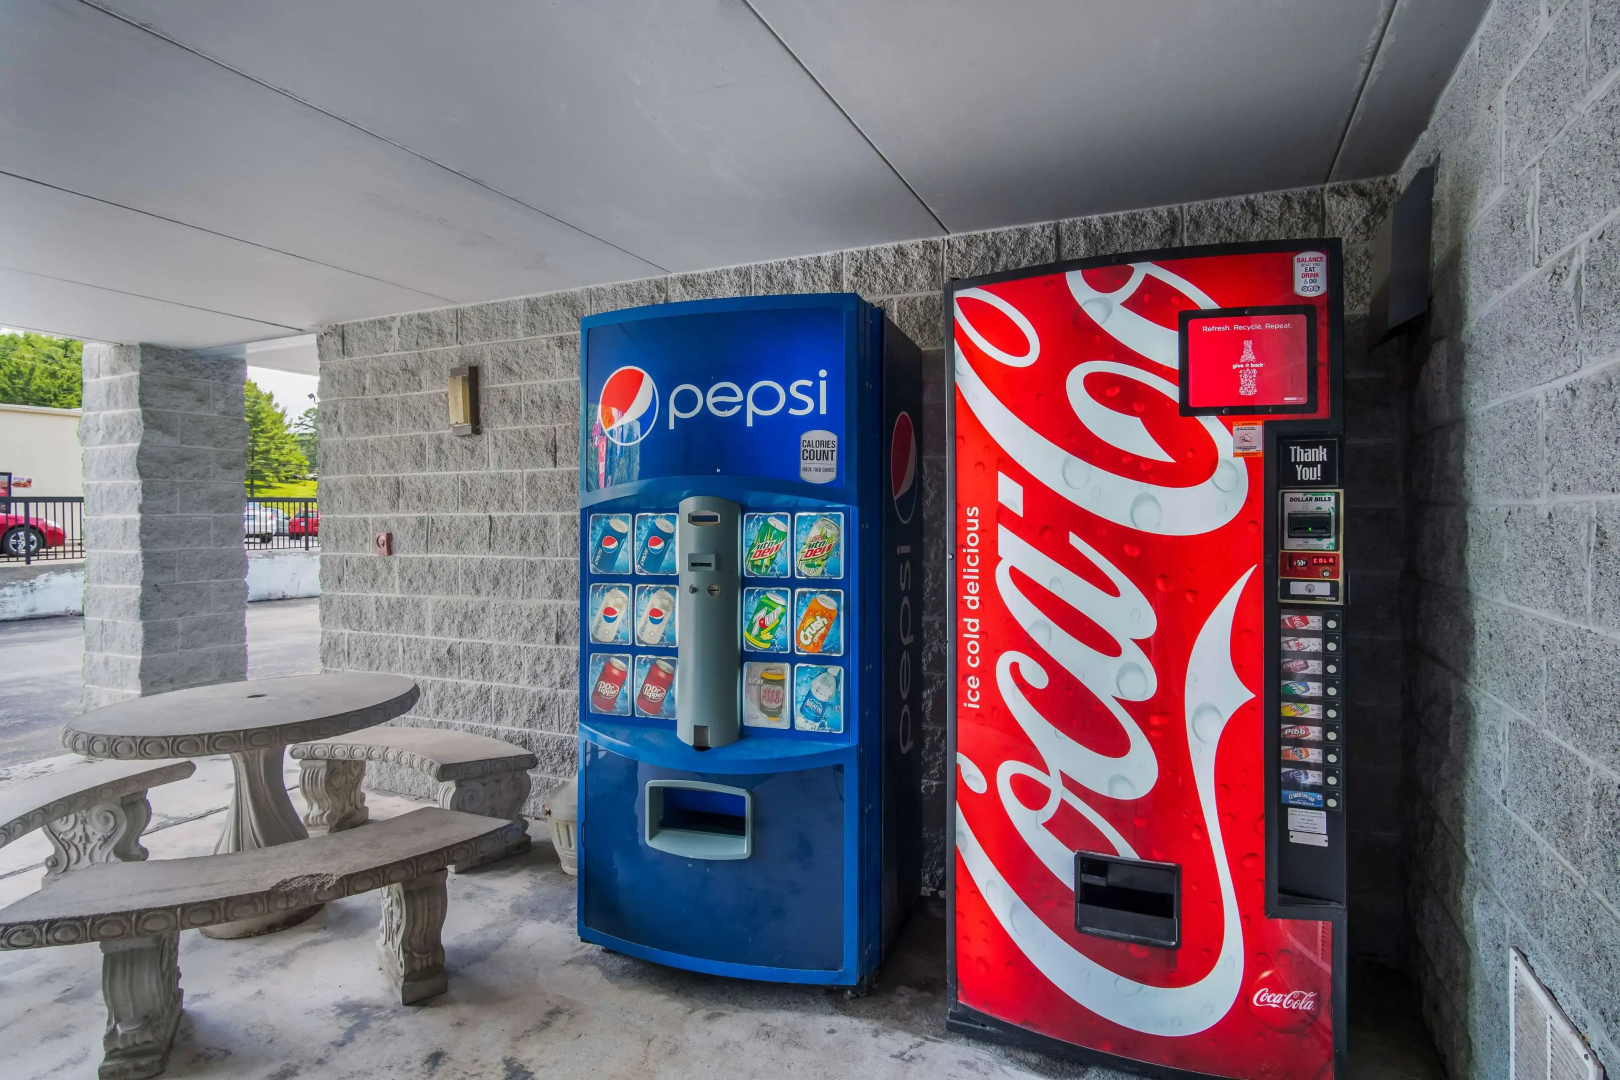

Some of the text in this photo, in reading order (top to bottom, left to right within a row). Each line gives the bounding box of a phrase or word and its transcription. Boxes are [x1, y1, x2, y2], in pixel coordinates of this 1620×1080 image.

[668, 369, 828, 430] pepsi
[801, 449, 836, 461] COUNT
[802, 439, 836, 448] CALORIES
[1289, 445, 1328, 462] Thank
[1295, 464, 1321, 480] You!
[962, 506, 980, 709] ice cold delicious
[799, 615, 829, 646] Crush
[897, 545, 914, 755] pepsi
